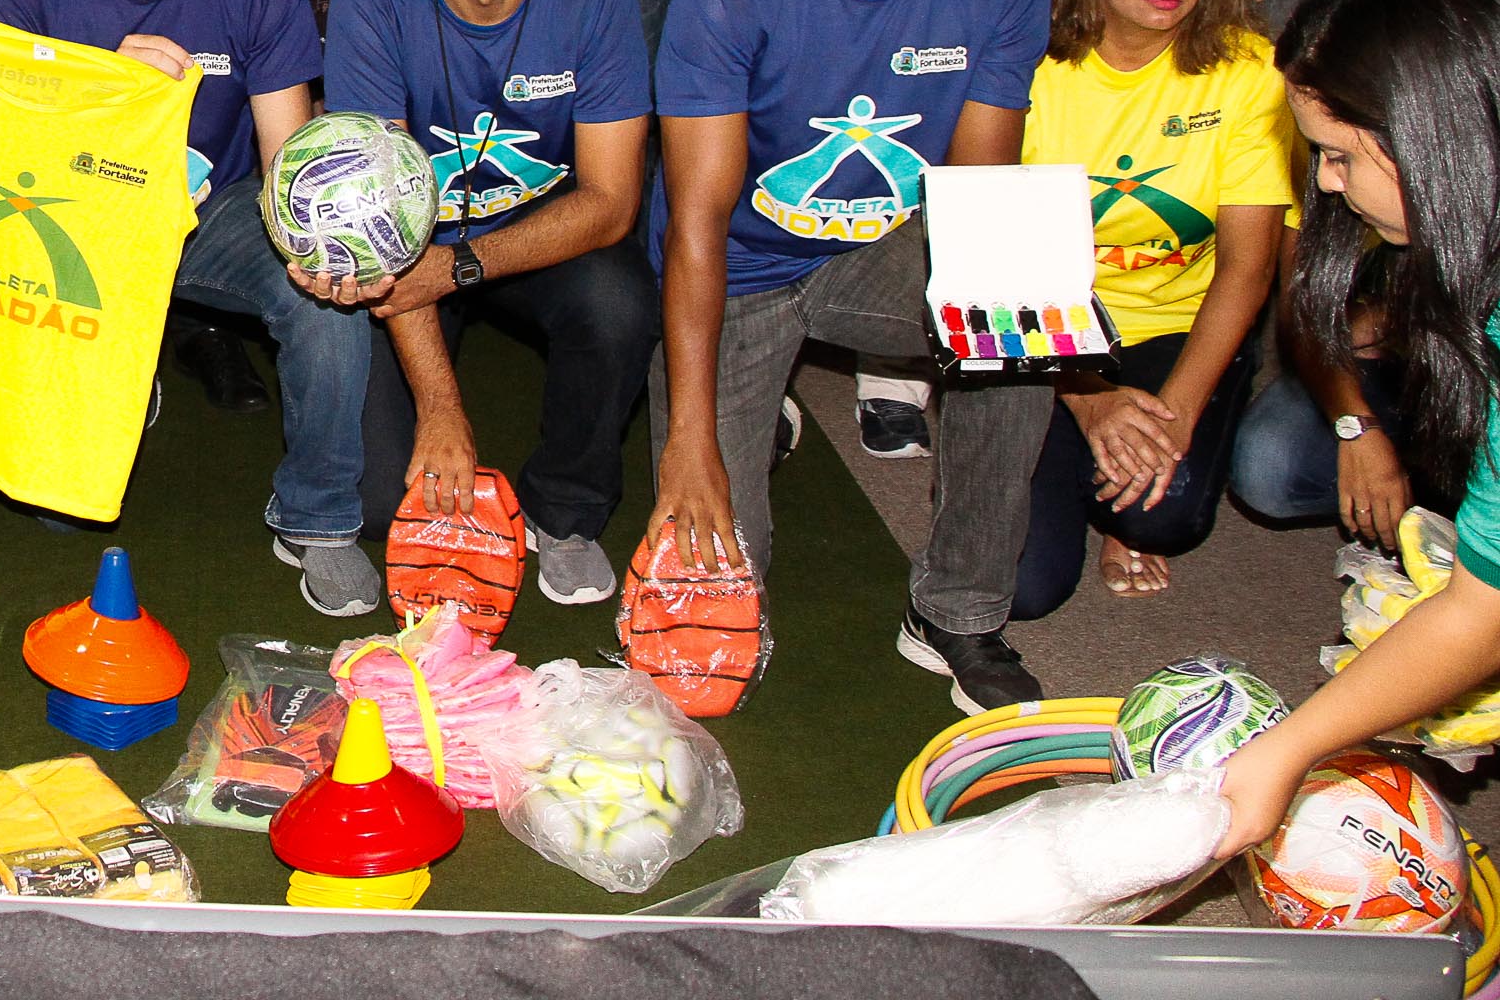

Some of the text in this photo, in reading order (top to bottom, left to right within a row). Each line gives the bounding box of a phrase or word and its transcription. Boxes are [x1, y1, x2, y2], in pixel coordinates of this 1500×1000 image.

[920, 50, 953, 58] Prefeitura
[920, 57, 964, 68] Fortaleza
[531, 76, 563, 85] Prefeitura
[532, 82, 574, 94] Fortaleza
[1189, 109, 1221, 121] Prefeitura
[100, 158, 148, 176] Prefeitura de
[98, 166, 146, 185] Fortaleza
[806, 200, 897, 214] ATLETA
[1340, 814, 1457, 900] PENALTY
